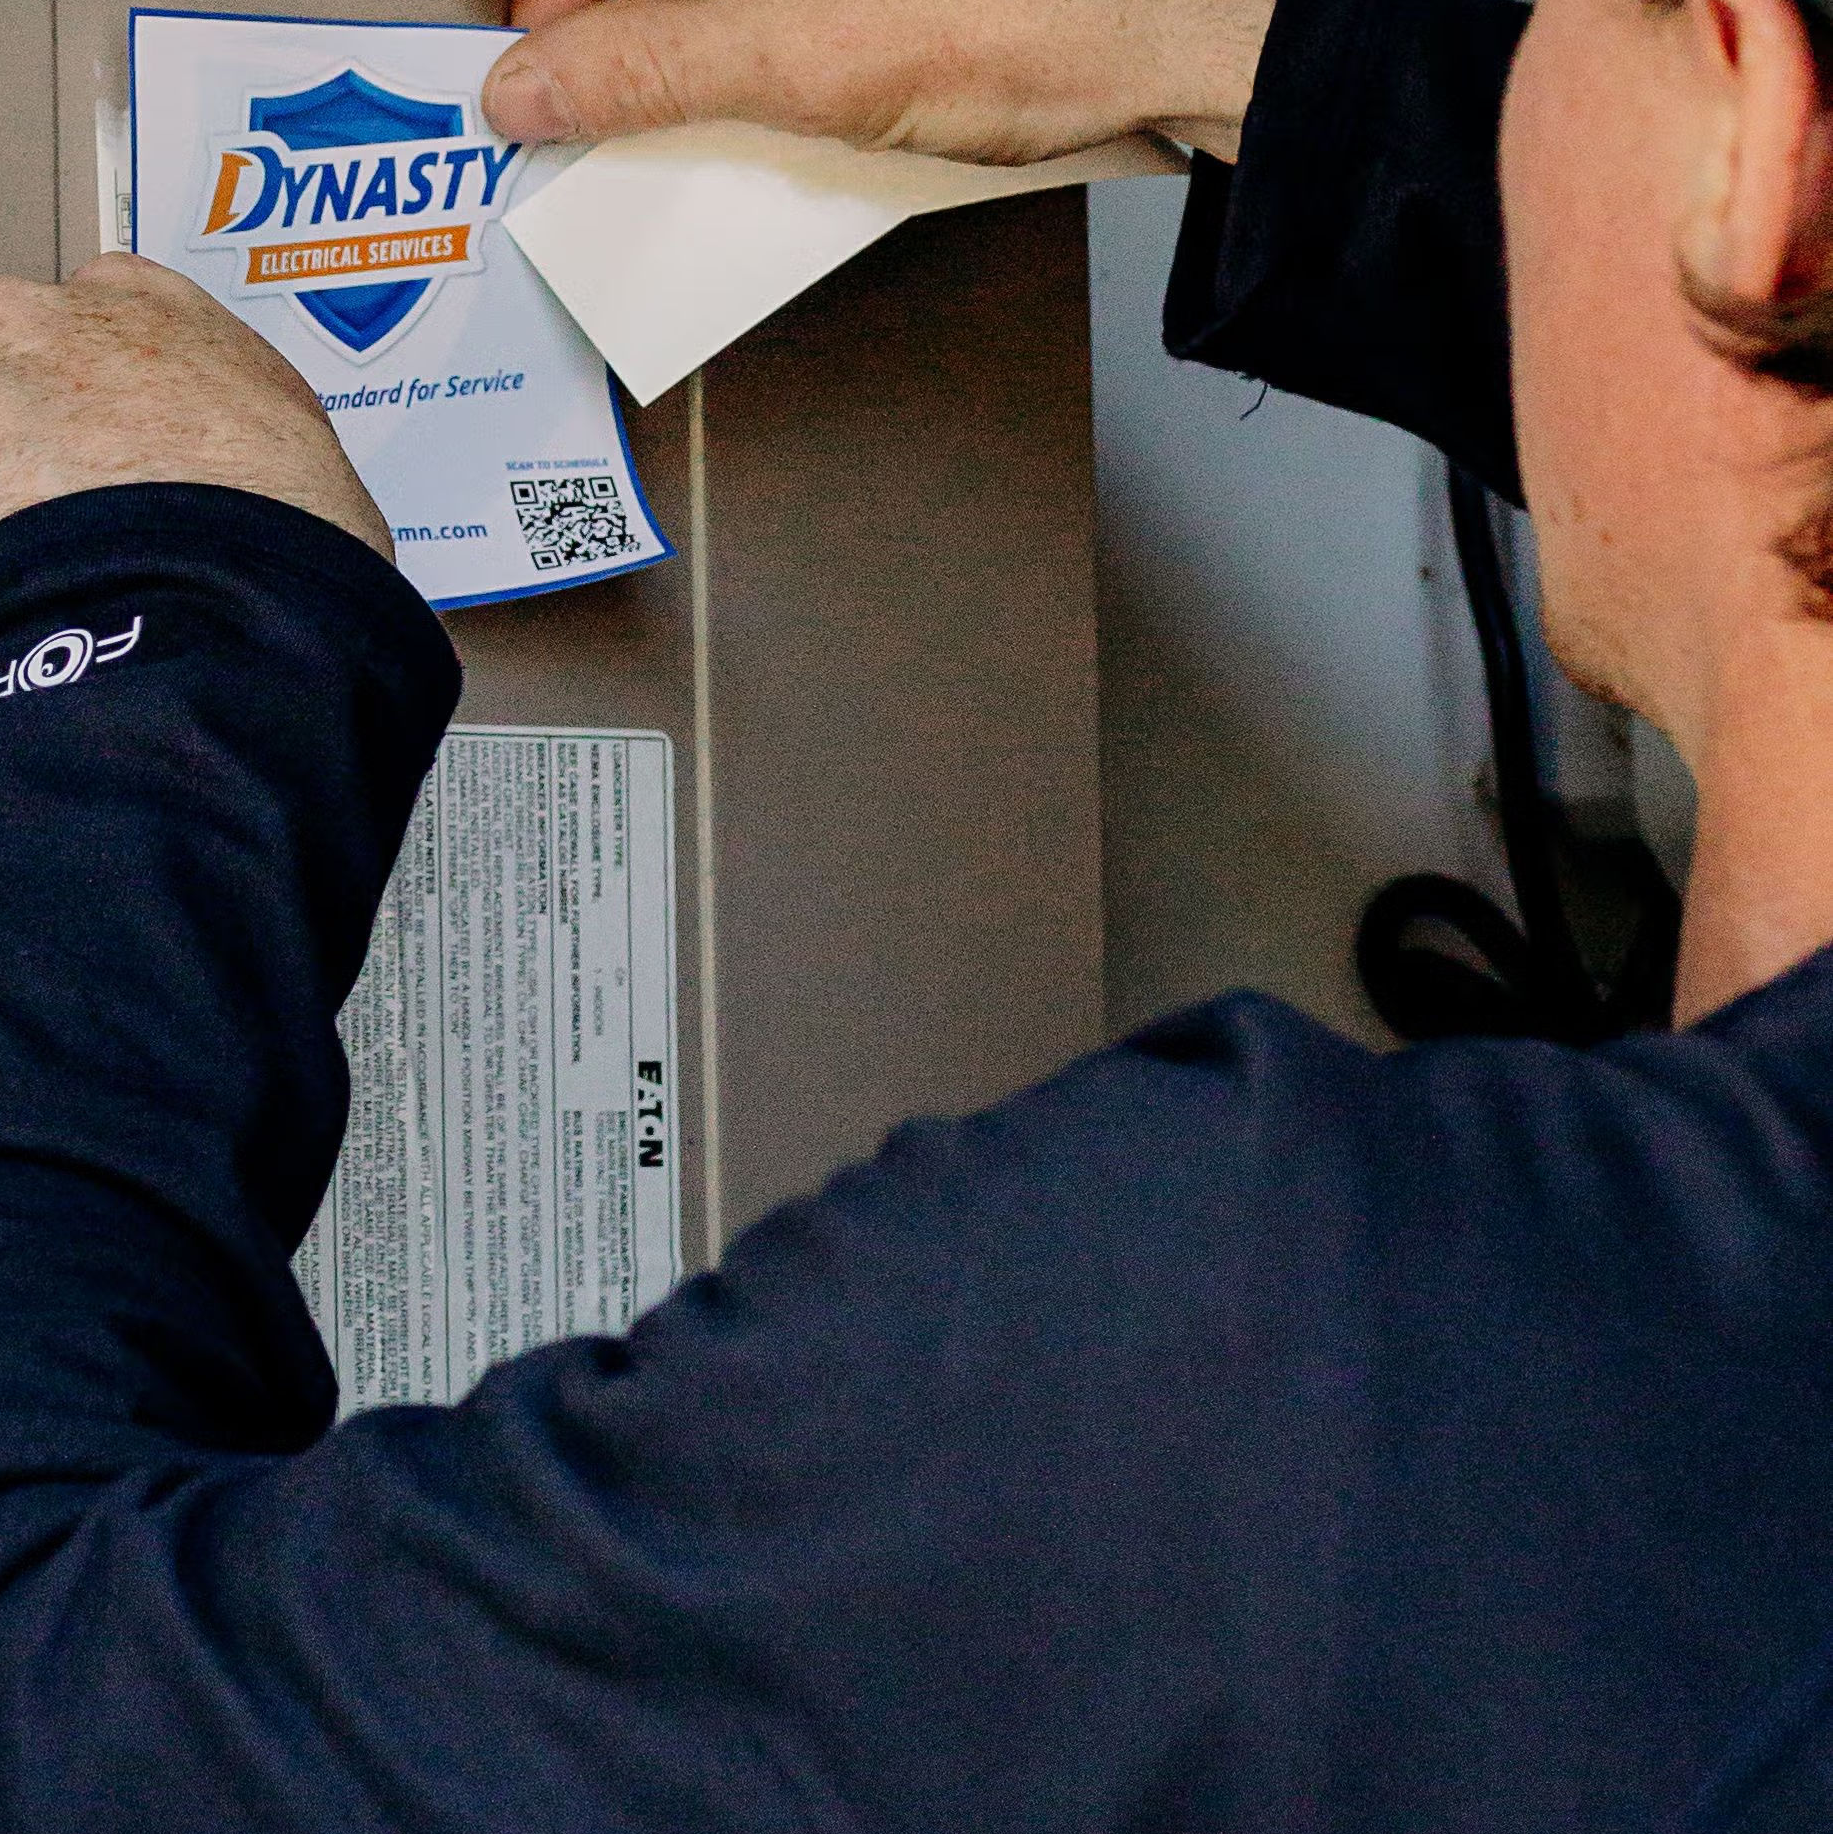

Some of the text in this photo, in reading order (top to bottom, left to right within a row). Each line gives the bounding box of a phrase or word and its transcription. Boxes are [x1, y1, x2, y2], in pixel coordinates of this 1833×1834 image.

[202, 142, 523, 237] DYNASTY
[260, 234, 453, 276] ELECTRICAL SERVICES
[406, 376, 440, 409] for
[445, 370, 524, 398] Service
[392, 522, 487, 542] mn.com
